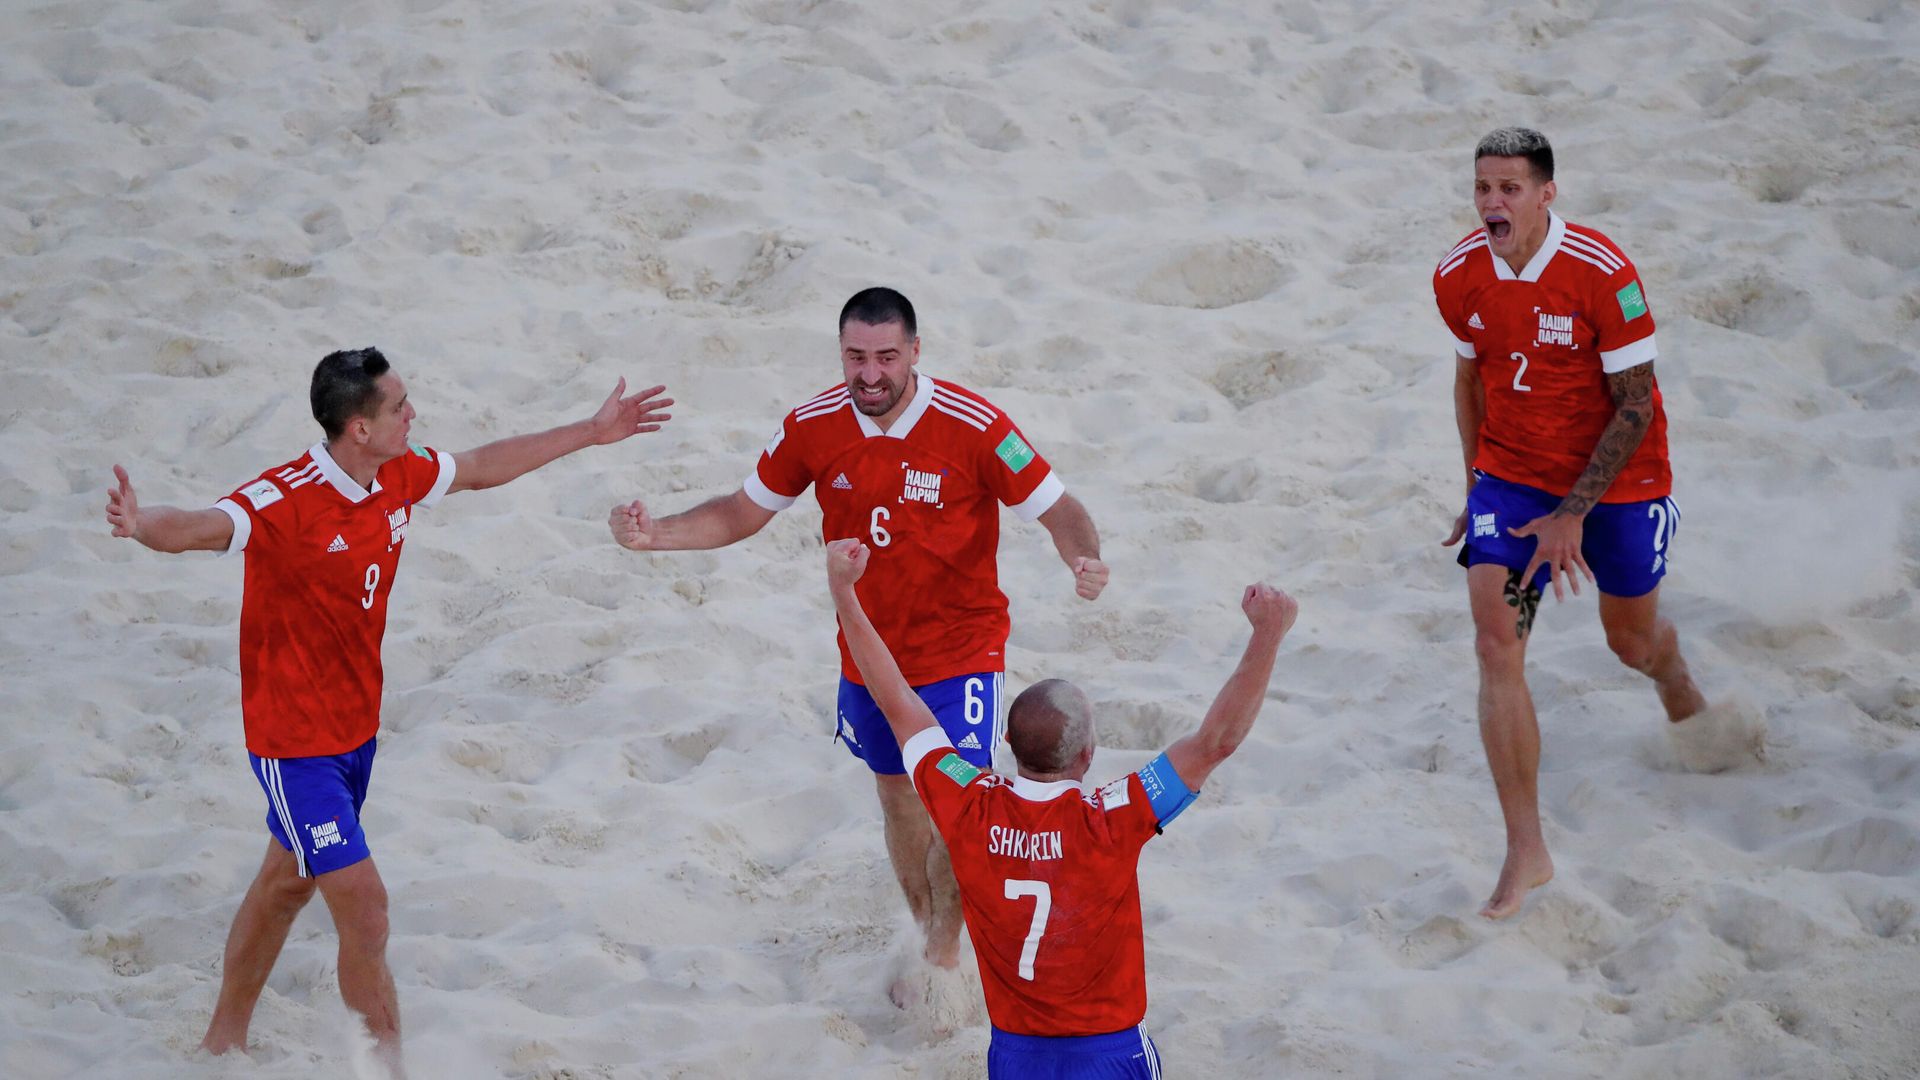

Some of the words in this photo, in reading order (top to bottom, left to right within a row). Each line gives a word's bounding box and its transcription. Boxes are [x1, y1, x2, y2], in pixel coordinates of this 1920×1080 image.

[1539, 313, 1573, 331] НАШИ
[1538, 329, 1573, 345] ПАРНИ
[1511, 352, 1532, 391] 2
[905, 469, 941, 489] НАШИ
[904, 485, 940, 503] ПАРНИ
[870, 506, 891, 547] 6
[1648, 503, 1666, 551] 2
[327, 544, 349, 552] adidas
[362, 563, 381, 609] 9
[964, 677, 984, 725] 6
[958, 742, 982, 750] adidas
[310, 820, 339, 839] НАШИ
[314, 832, 342, 849] ПАРНИ
[1004, 878, 1052, 981] 7
